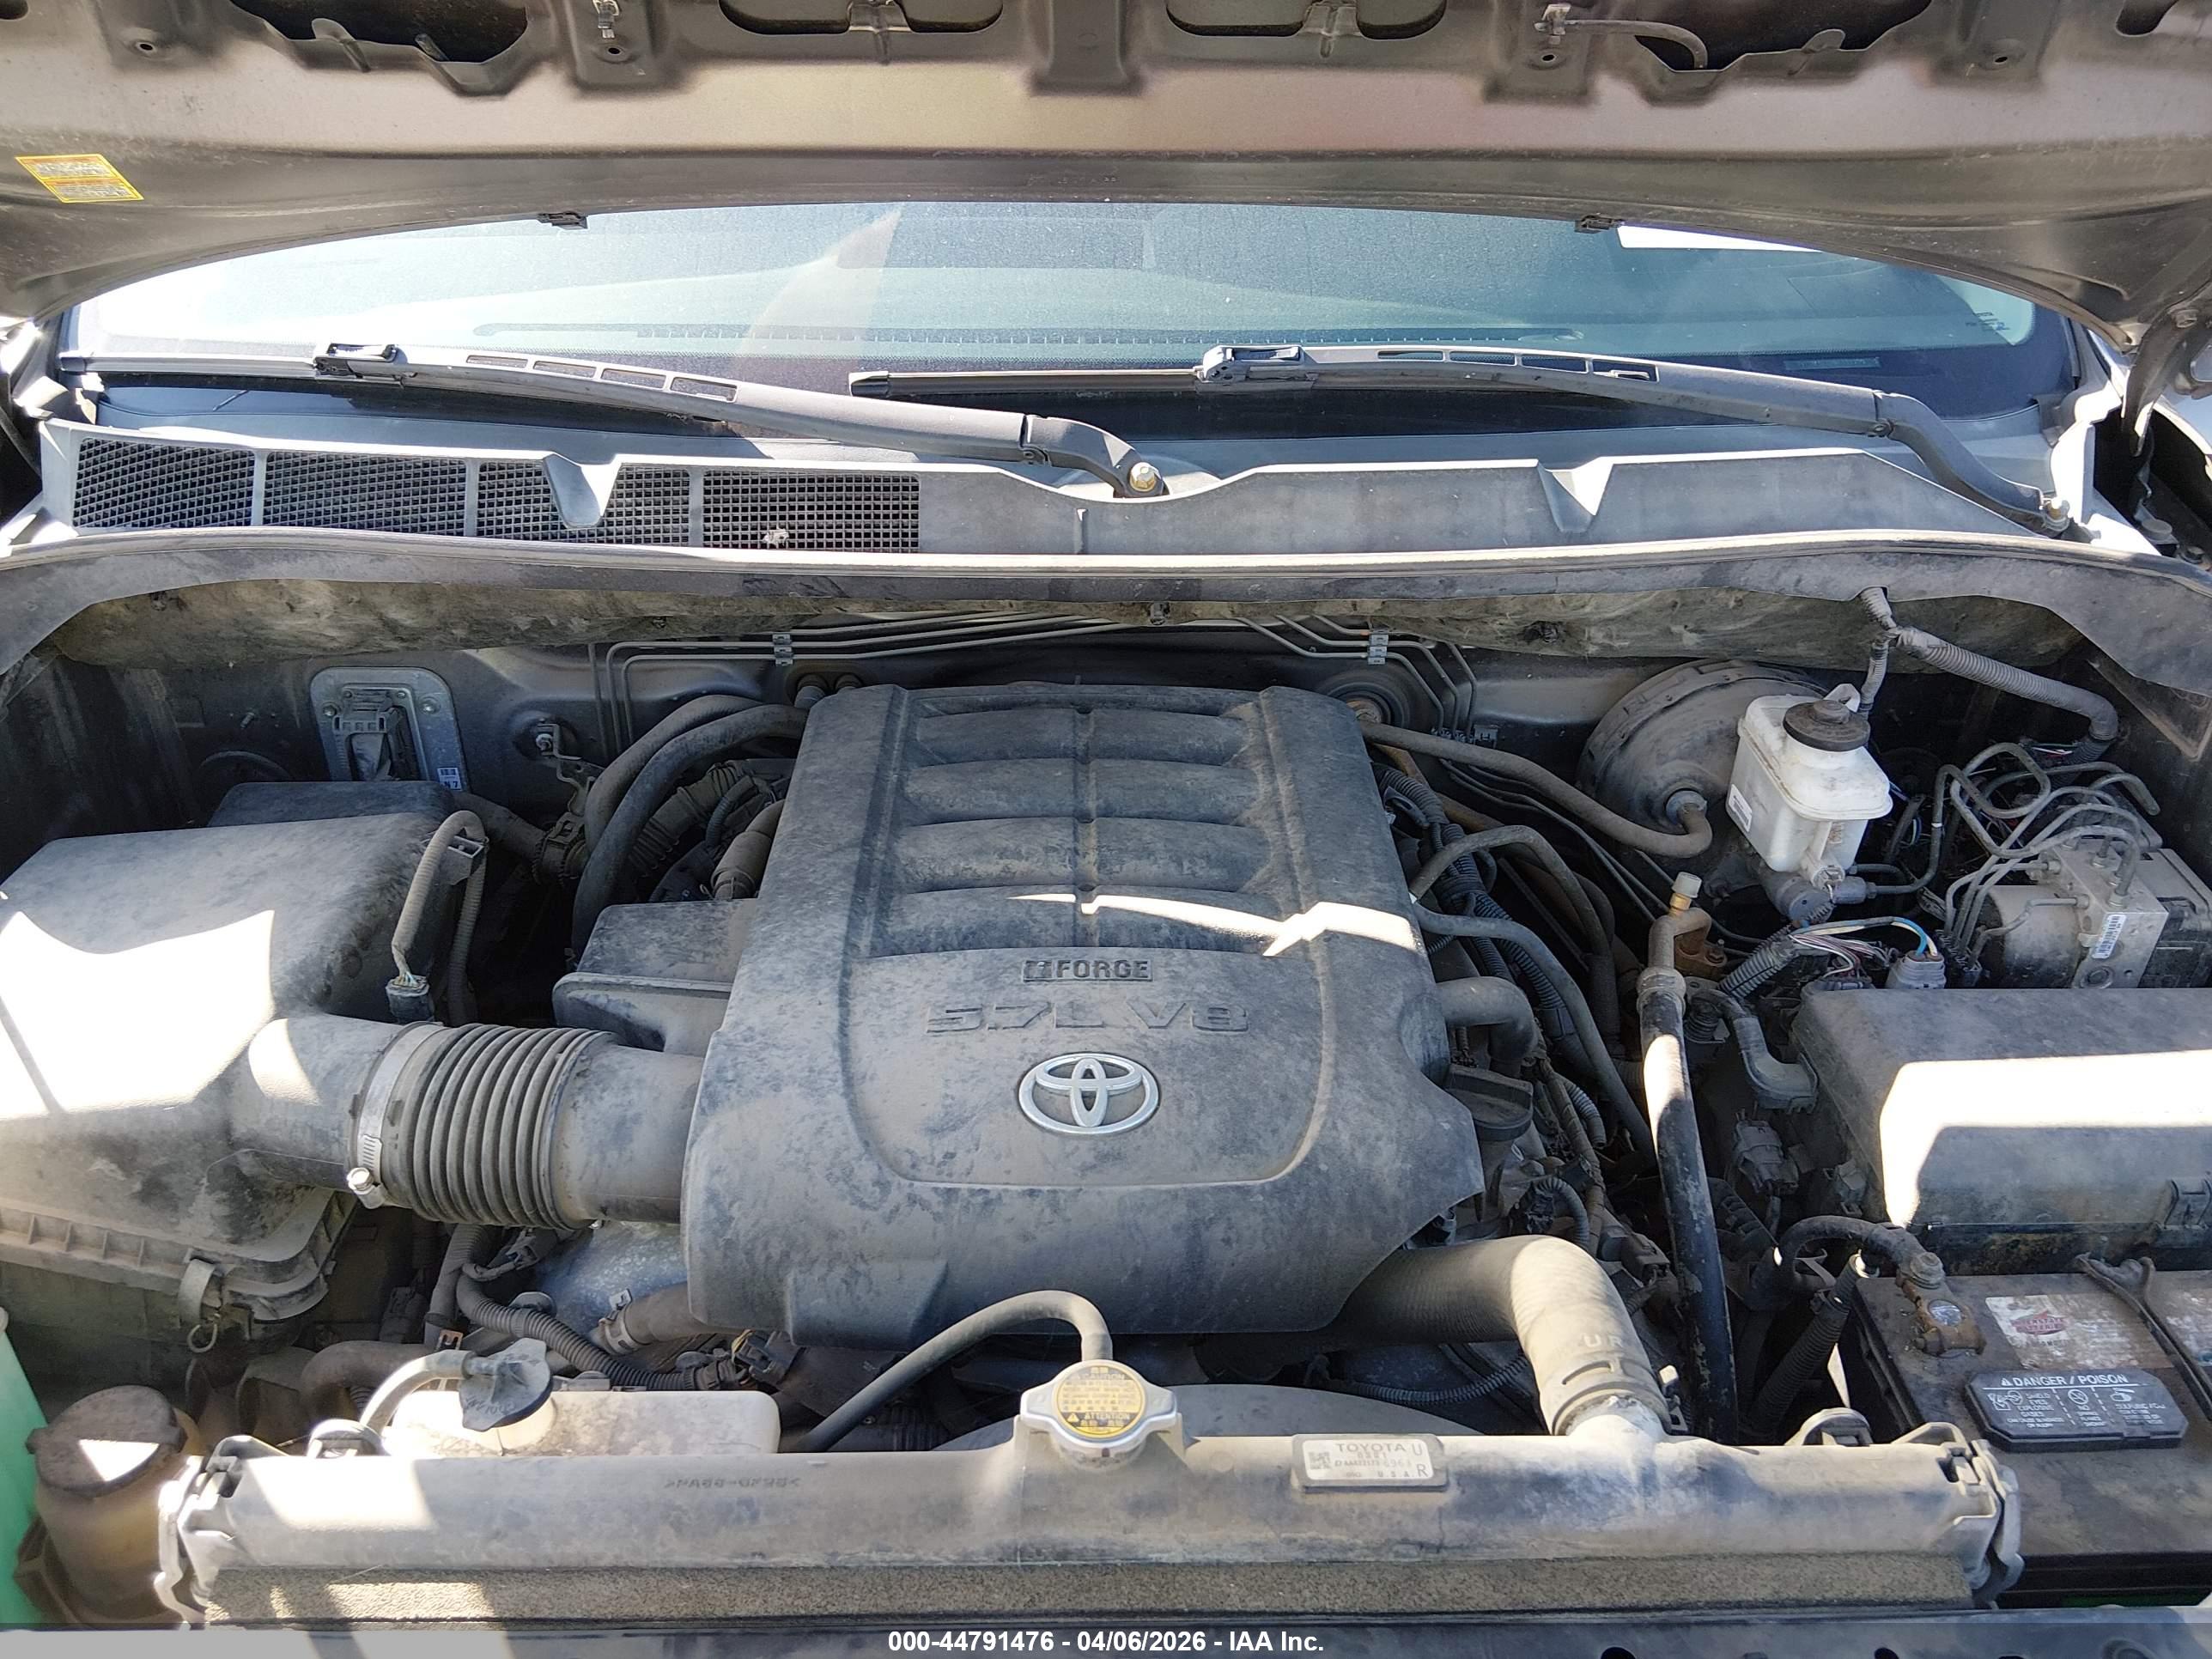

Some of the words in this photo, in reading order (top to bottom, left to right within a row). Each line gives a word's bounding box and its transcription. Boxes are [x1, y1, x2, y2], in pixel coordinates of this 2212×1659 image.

[1126, 1000, 1249, 1032] V8
[2012, 1376, 2068, 1387] DANGER
[2078, 1374, 2129, 1385] POISON
[1335, 1443, 1407, 1453] TOYOTA
[1412, 1443, 1423, 1456] U
[1416, 1463, 1429, 1478] R
